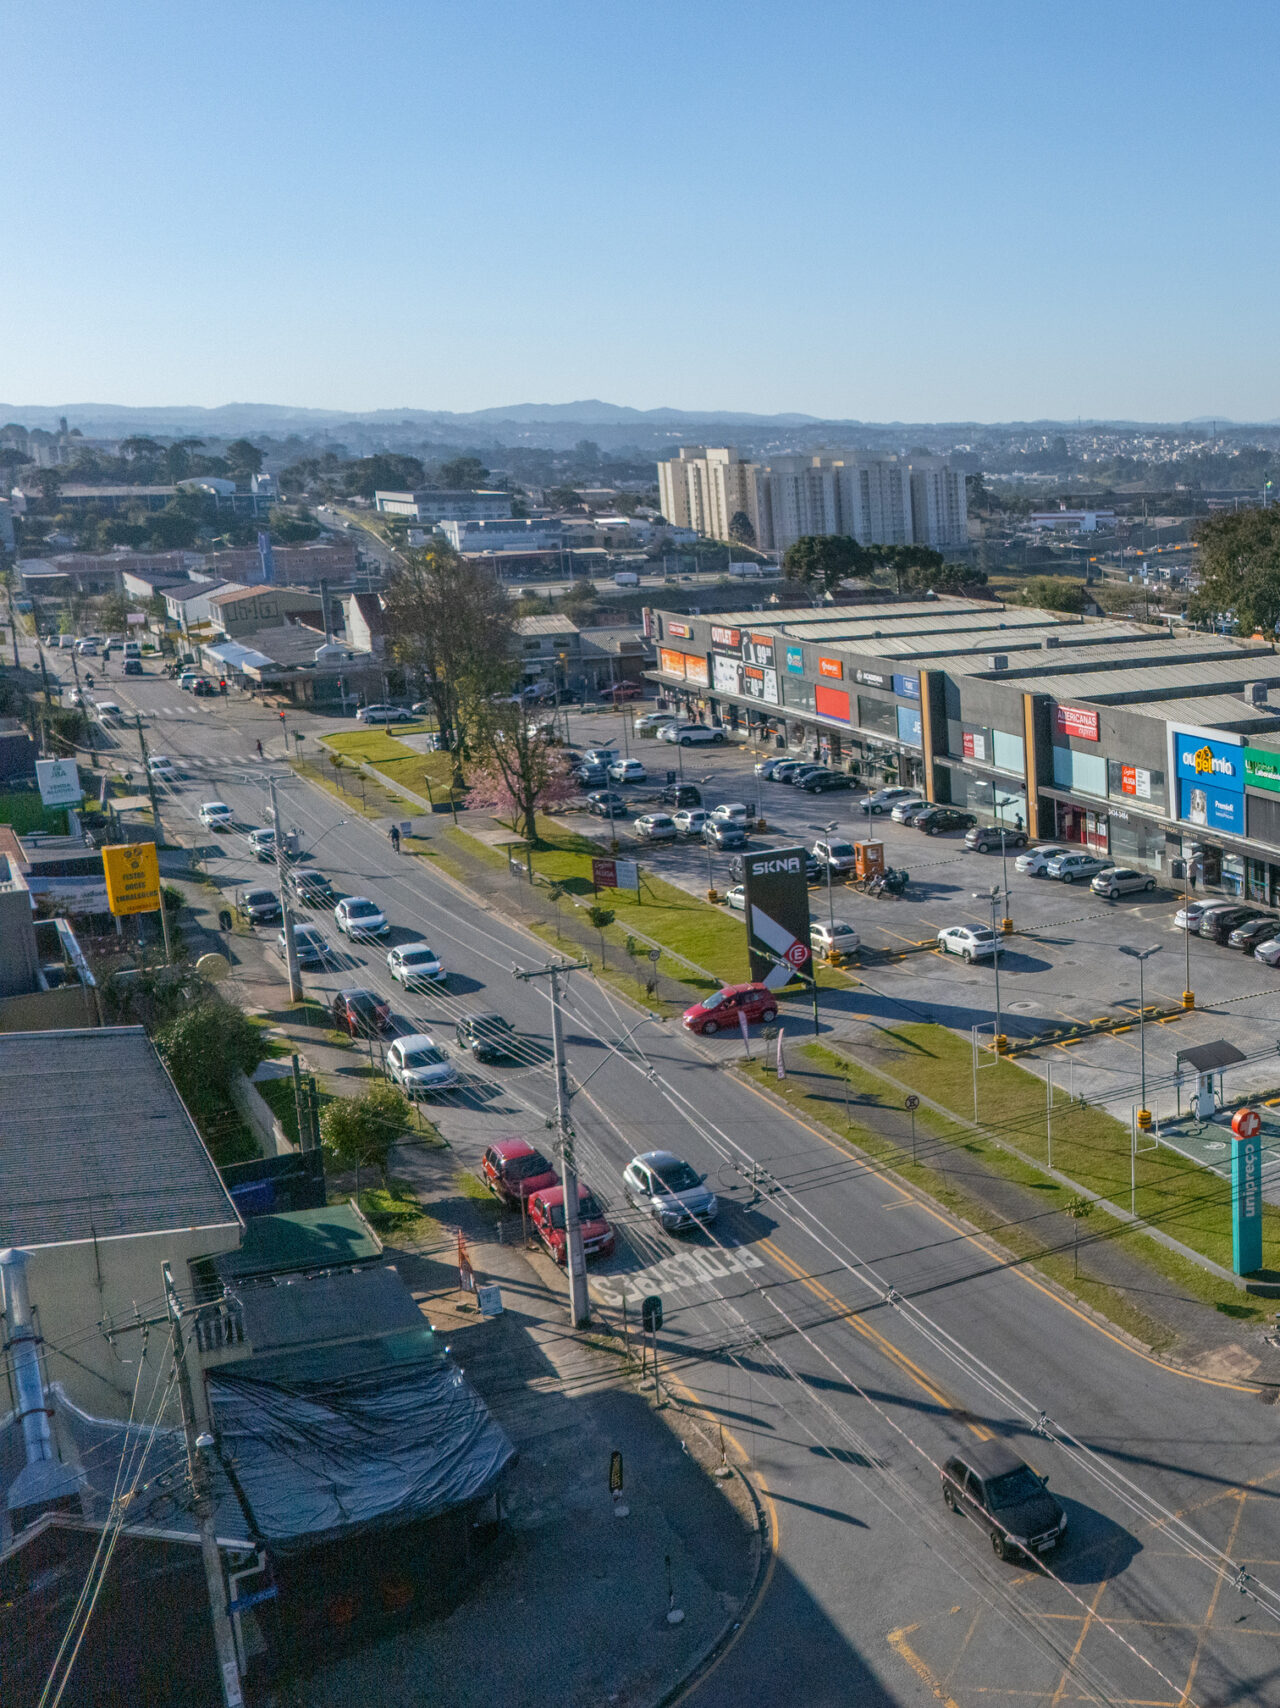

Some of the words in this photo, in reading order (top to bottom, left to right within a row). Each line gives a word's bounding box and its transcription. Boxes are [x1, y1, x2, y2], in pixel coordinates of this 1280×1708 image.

[711, 626, 732, 645] OUTLET
[1057, 708, 1097, 727] AMERICANAS
[752, 857, 800, 876] SKNA
[1245, 1143, 1258, 1218] unipreço
[589, 1246, 765, 1305] PEDESTRES
